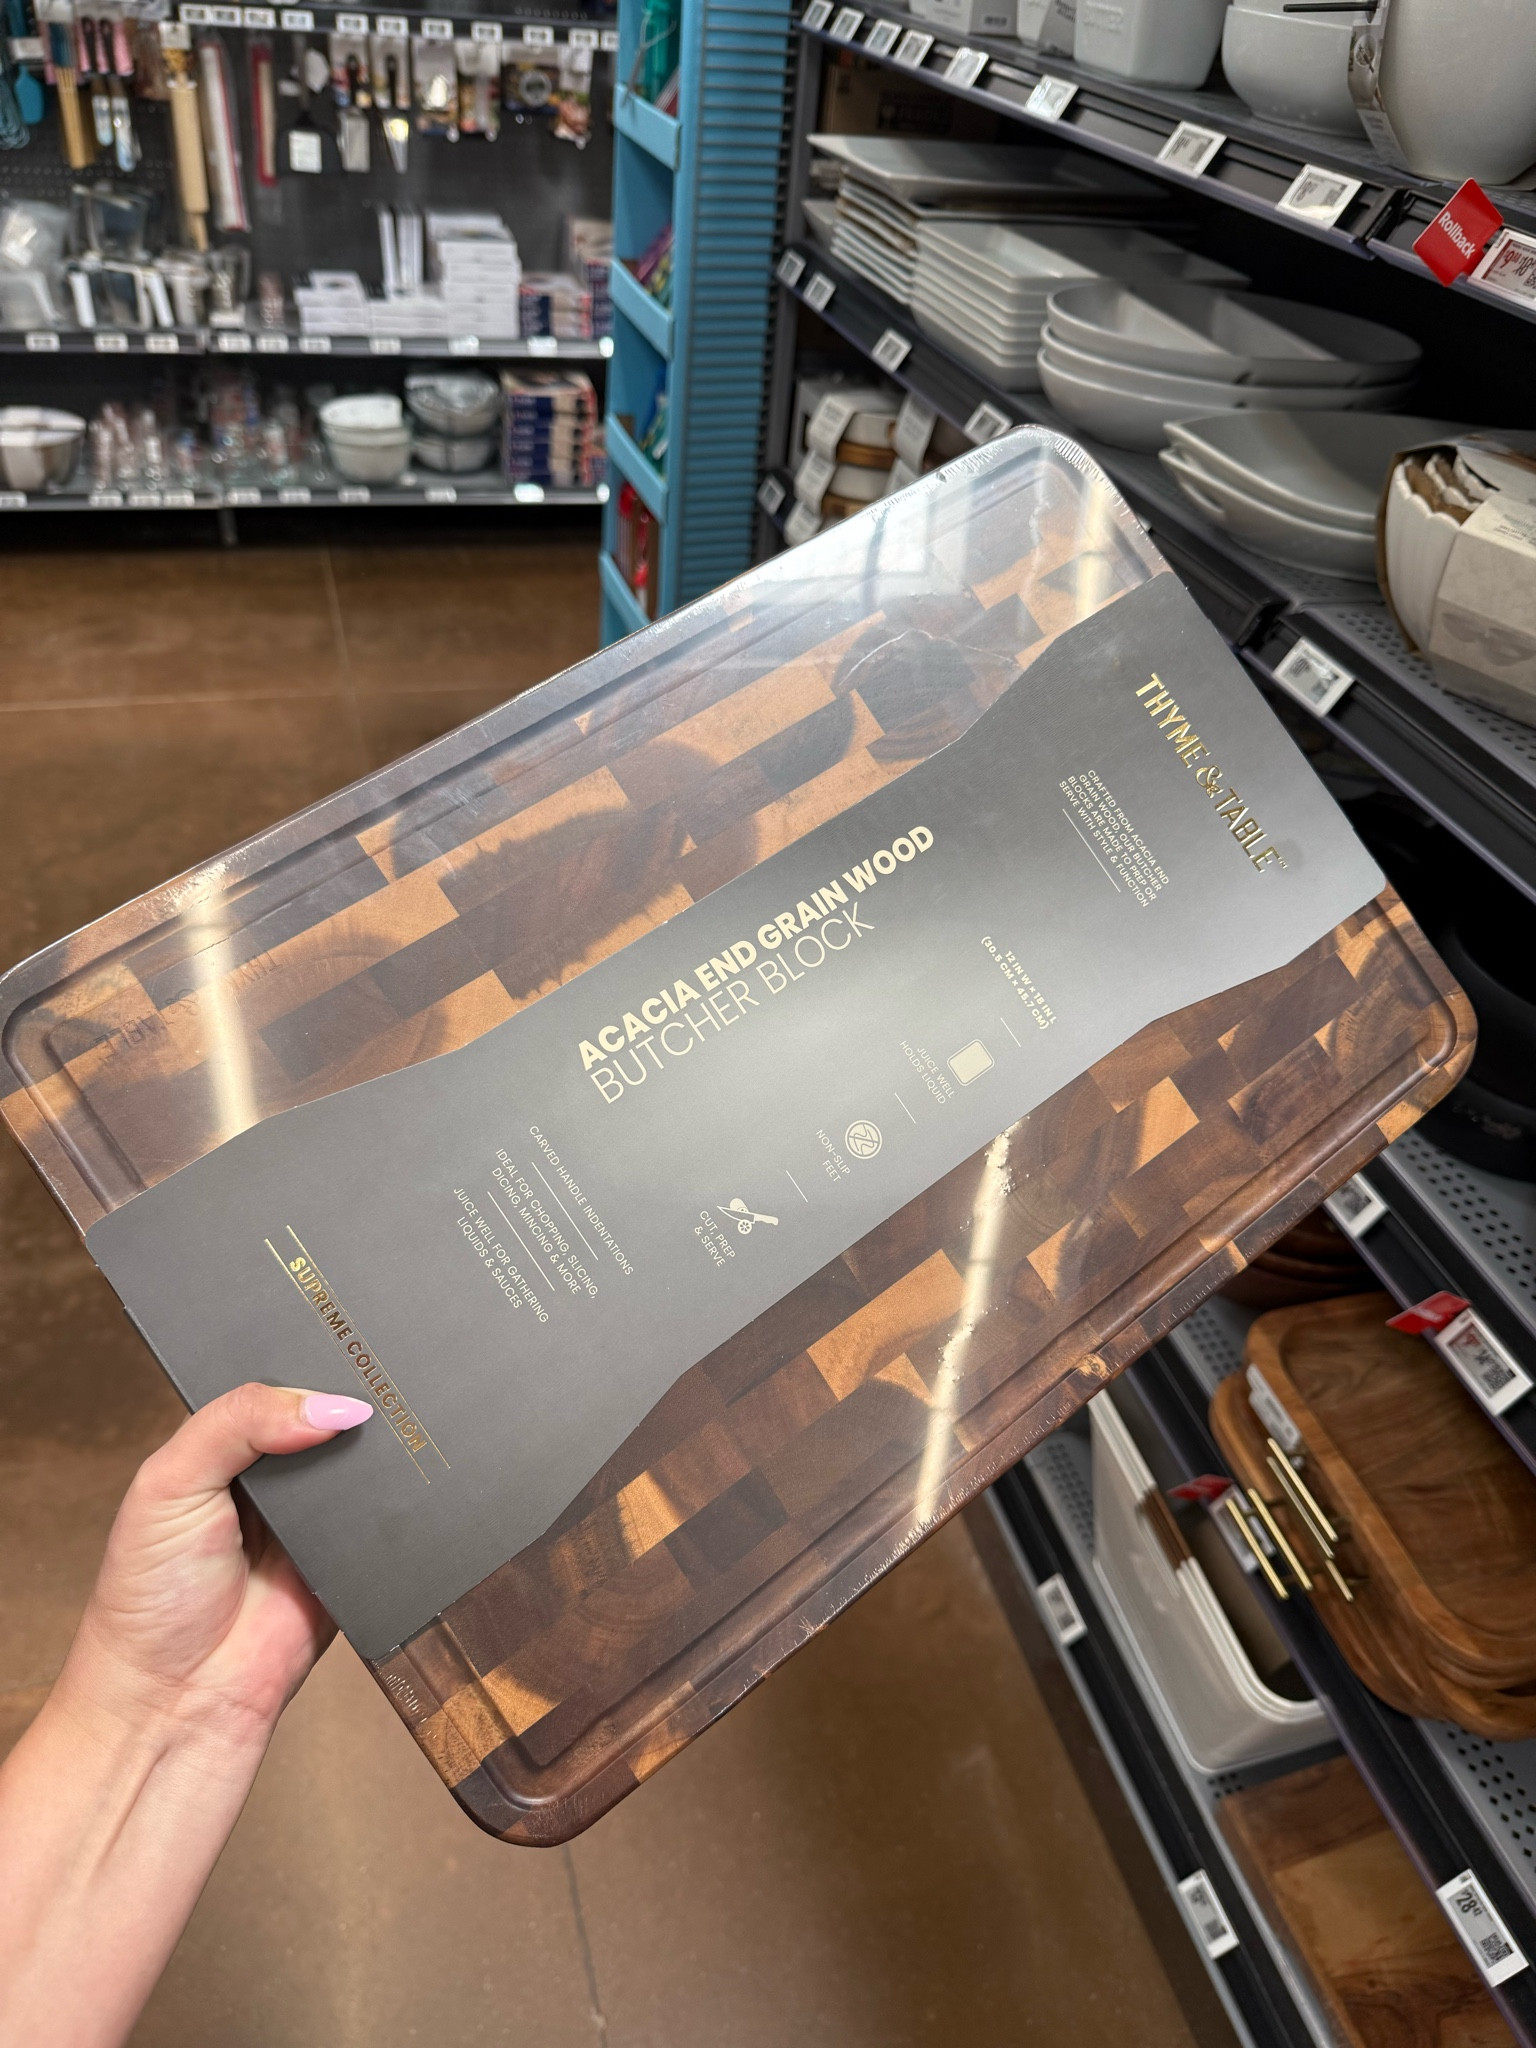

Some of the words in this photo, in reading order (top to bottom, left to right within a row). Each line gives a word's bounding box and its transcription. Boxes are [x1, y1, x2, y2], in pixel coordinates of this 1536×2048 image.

[1438, 210, 1477, 260] Rollback
[1136, 672, 1211, 769] THYME
[1196, 765, 1223, 798] &
[1059, 781, 1080, 807] SERVE
[1078, 807, 1095, 830] WITH
[1093, 830, 1113, 855] STYLE
[1110, 855, 1118, 864] &
[1116, 864, 1148, 906] FUNCTION
[1068, 776, 1093, 809] BLOCKS
[1091, 811, 1105, 826] ARE
[1103, 827, 1122, 852] MADE
[1120, 851, 1132, 865] TO
[1130, 866, 1146, 884] PREP
[1144, 886, 1157, 901] OR
[1080, 775, 1100, 801] GRAIN
[1099, 802, 1120, 833] WOOD,
[1120, 834, 1135, 852] OUR
[1133, 853, 1161, 890] BUTCHER
[1088, 770, 1116, 807] CRAFTED
[1114, 808, 1134, 833] FROM
[1131, 835, 1156, 866] ACACIA
[1154, 867, 1168, 884] END
[578, 979, 702, 1071] ACACIA
[694, 939, 757, 991] END
[757, 880, 849, 950] GRAIN
[841, 825, 934, 894] WOOD
[590, 979, 760, 1104] BUTCHER
[755, 901, 875, 995] BLOCK
[1017, 988, 1034, 1006] 45.7
[1032, 1009, 1049, 1029] CM)
[900, 1041, 924, 1072] HOLDS
[922, 1073, 945, 1103] LIQUID
[918, 1049, 938, 1074] JUICE
[937, 1073, 954, 1098] WELL
[530, 1126, 559, 1165] CARVED
[557, 1166, 587, 1205] HANDLE
[584, 1205, 633, 1274] INDENTATIONS
[816, 1130, 850, 1173] NON-SLIP
[823, 1160, 841, 1181] FEET
[454, 1189, 478, 1217] JUICE
[475, 1217, 495, 1244] WELL
[492, 1243, 510, 1265] FOR
[508, 1266, 548, 1322] GATHERING
[457, 1217, 488, 1257] LIQUIDS
[484, 1257, 495, 1269] &
[492, 1268, 522, 1308] SAUCES
[492, 1168, 520, 1207] DICING,
[519, 1207, 553, 1252] MINCING
[549, 1253, 560, 1264] &
[557, 1263, 581, 1294] MORE
[496, 1149, 518, 1177] IDEAL
[516, 1178, 533, 1199] FOR
[531, 1200, 569, 1255] CHOPPING,
[568, 1255, 598, 1298] SLICING,
[694, 1225, 704, 1236] &
[702, 1236, 725, 1266] SERVE
[700, 1211, 717, 1235] CUT,
[716, 1234, 735, 1257] PREP
[290, 1256, 353, 1341] SUPREME
[347, 1341, 427, 1453] COLLECTION
